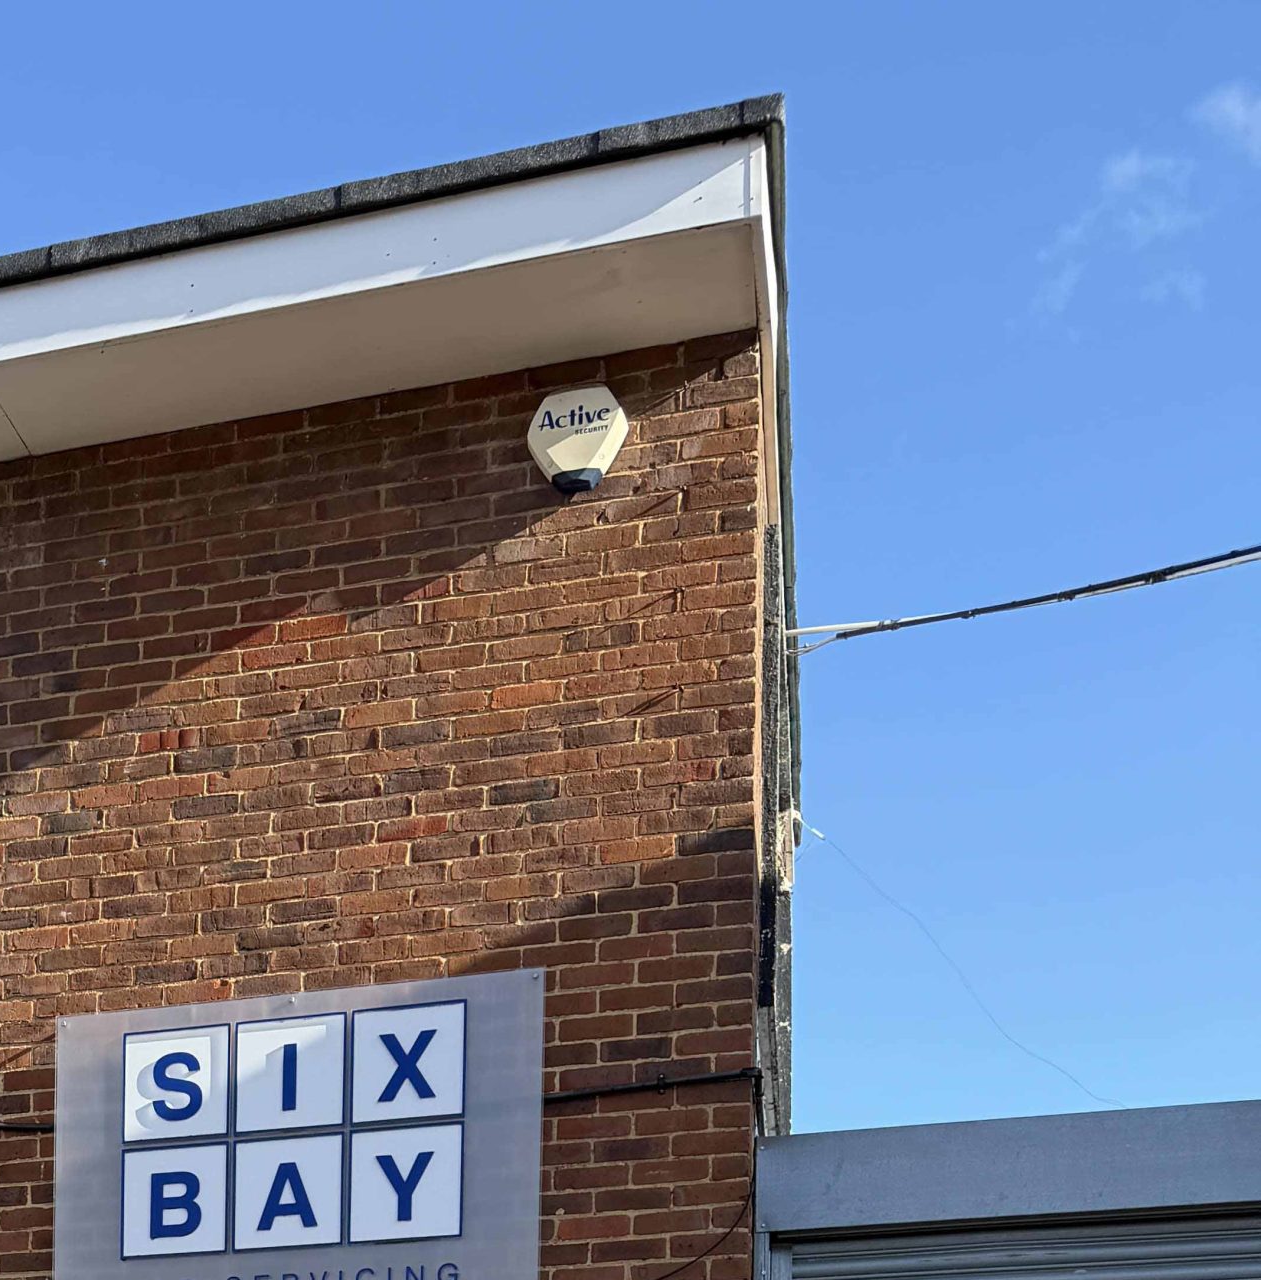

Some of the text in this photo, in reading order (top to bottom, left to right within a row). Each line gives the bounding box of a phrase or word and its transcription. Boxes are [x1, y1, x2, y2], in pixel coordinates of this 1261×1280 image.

[538, 404, 611, 431] Active
[574, 424, 609, 435] SECURITY
[151, 1028, 438, 1122] SIX
[149, 1151, 436, 1240] BAY
